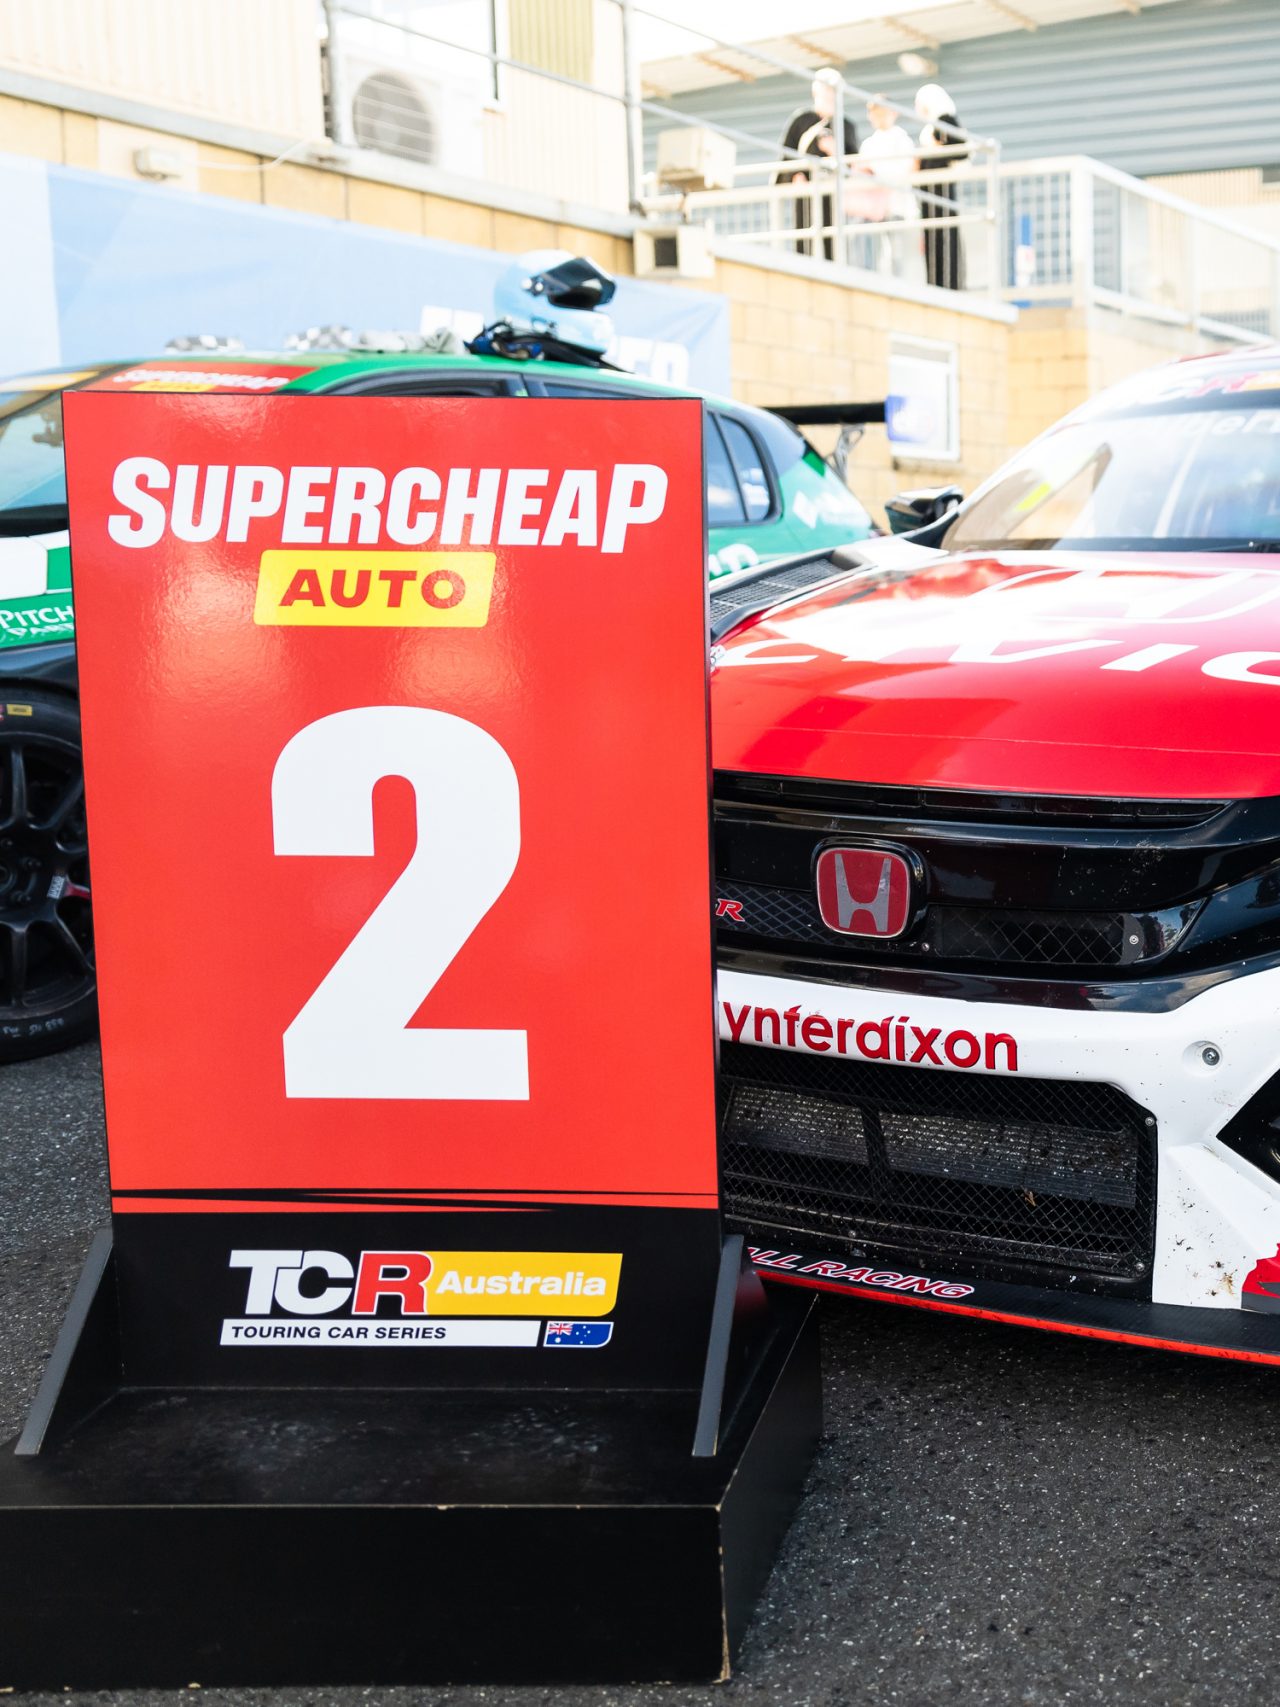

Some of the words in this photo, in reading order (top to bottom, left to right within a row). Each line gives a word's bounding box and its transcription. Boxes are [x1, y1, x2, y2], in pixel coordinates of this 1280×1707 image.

[108, 456, 669, 554] SUPERCHEAP
[279, 568, 467, 609] AUTO
[0, 605, 74, 629] PITCH
[270, 705, 530, 1101] 2
[229, 1249, 434, 1315] TCR
[436, 1270, 608, 1297] Australia
[799, 1259, 976, 1299] RACING
[231, 1326, 321, 1340] TOURING
[327, 1326, 372, 1340] CAR
[375, 1326, 447, 1340] SERIES
